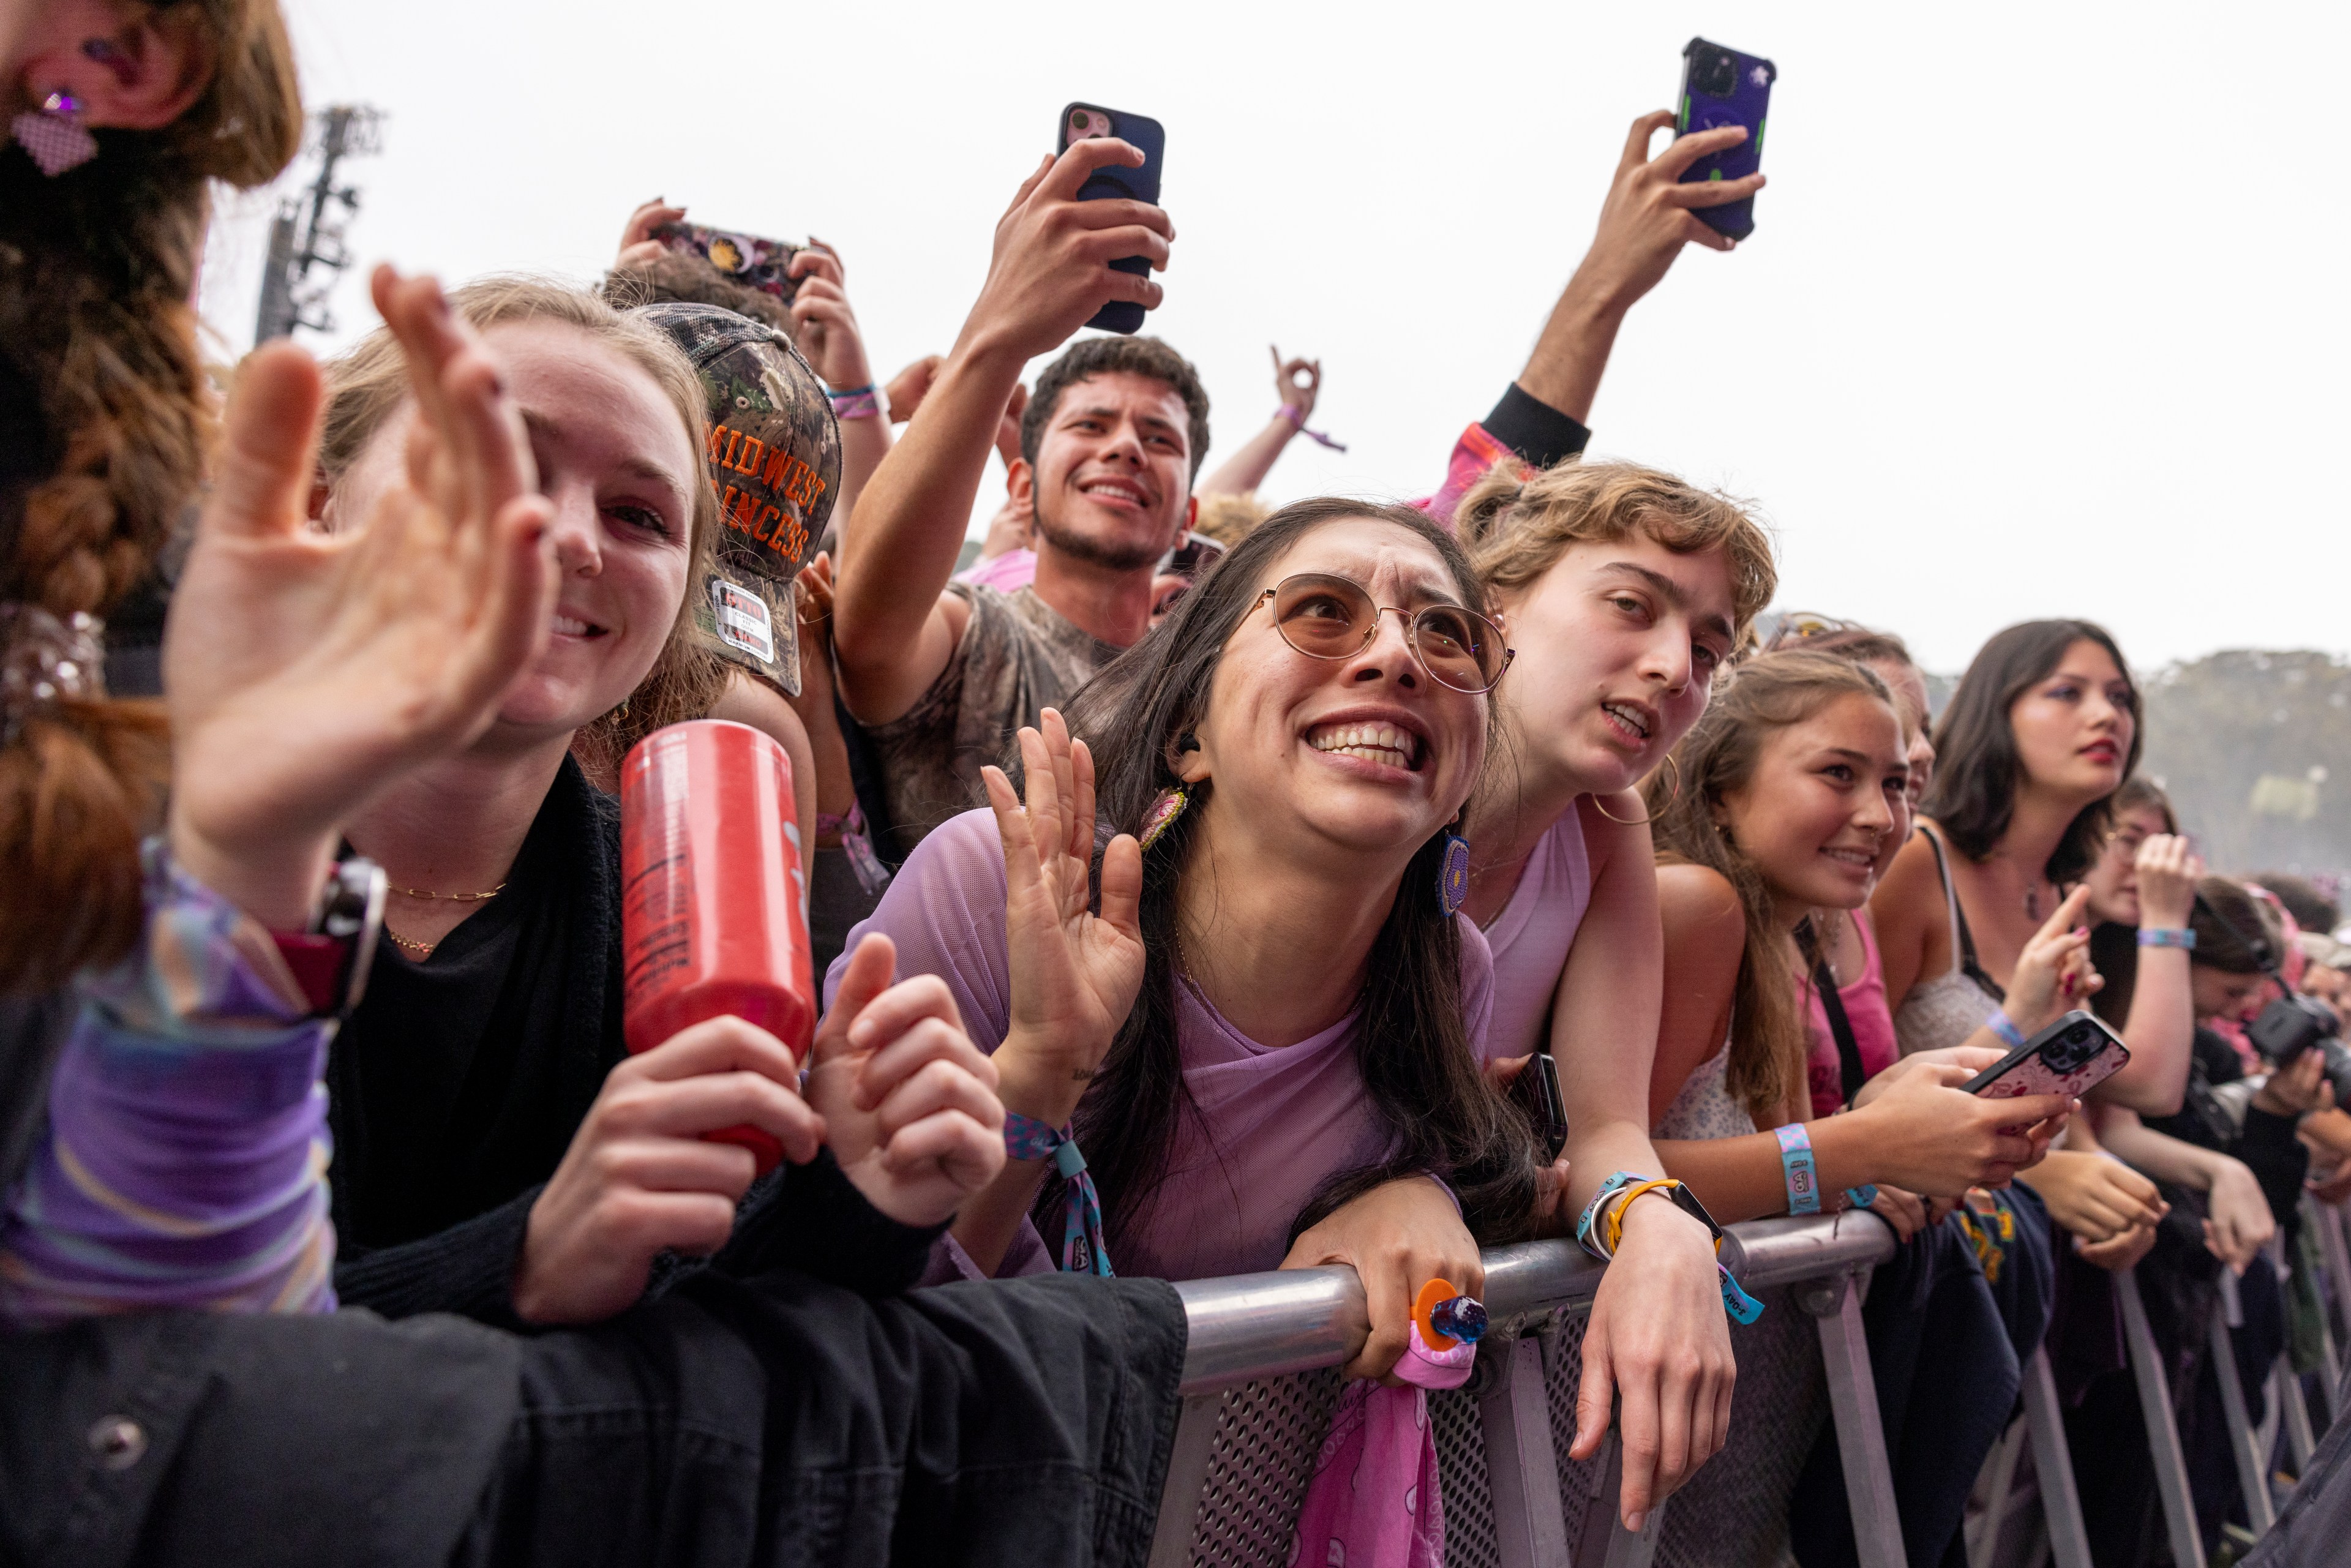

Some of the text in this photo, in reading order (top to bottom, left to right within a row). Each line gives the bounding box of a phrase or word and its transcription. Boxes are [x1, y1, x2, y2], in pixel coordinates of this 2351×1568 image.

[711, 479, 809, 563] INCESS
[726, 592, 762, 618] OTTO
[735, 612, 757, 625] CLASSIC
[729, 639, 768, 659] MAXIMUM COMFORT
[735, 631, 762, 647] CAMO
[1723, 1293, 1746, 1316] 3-DAY
